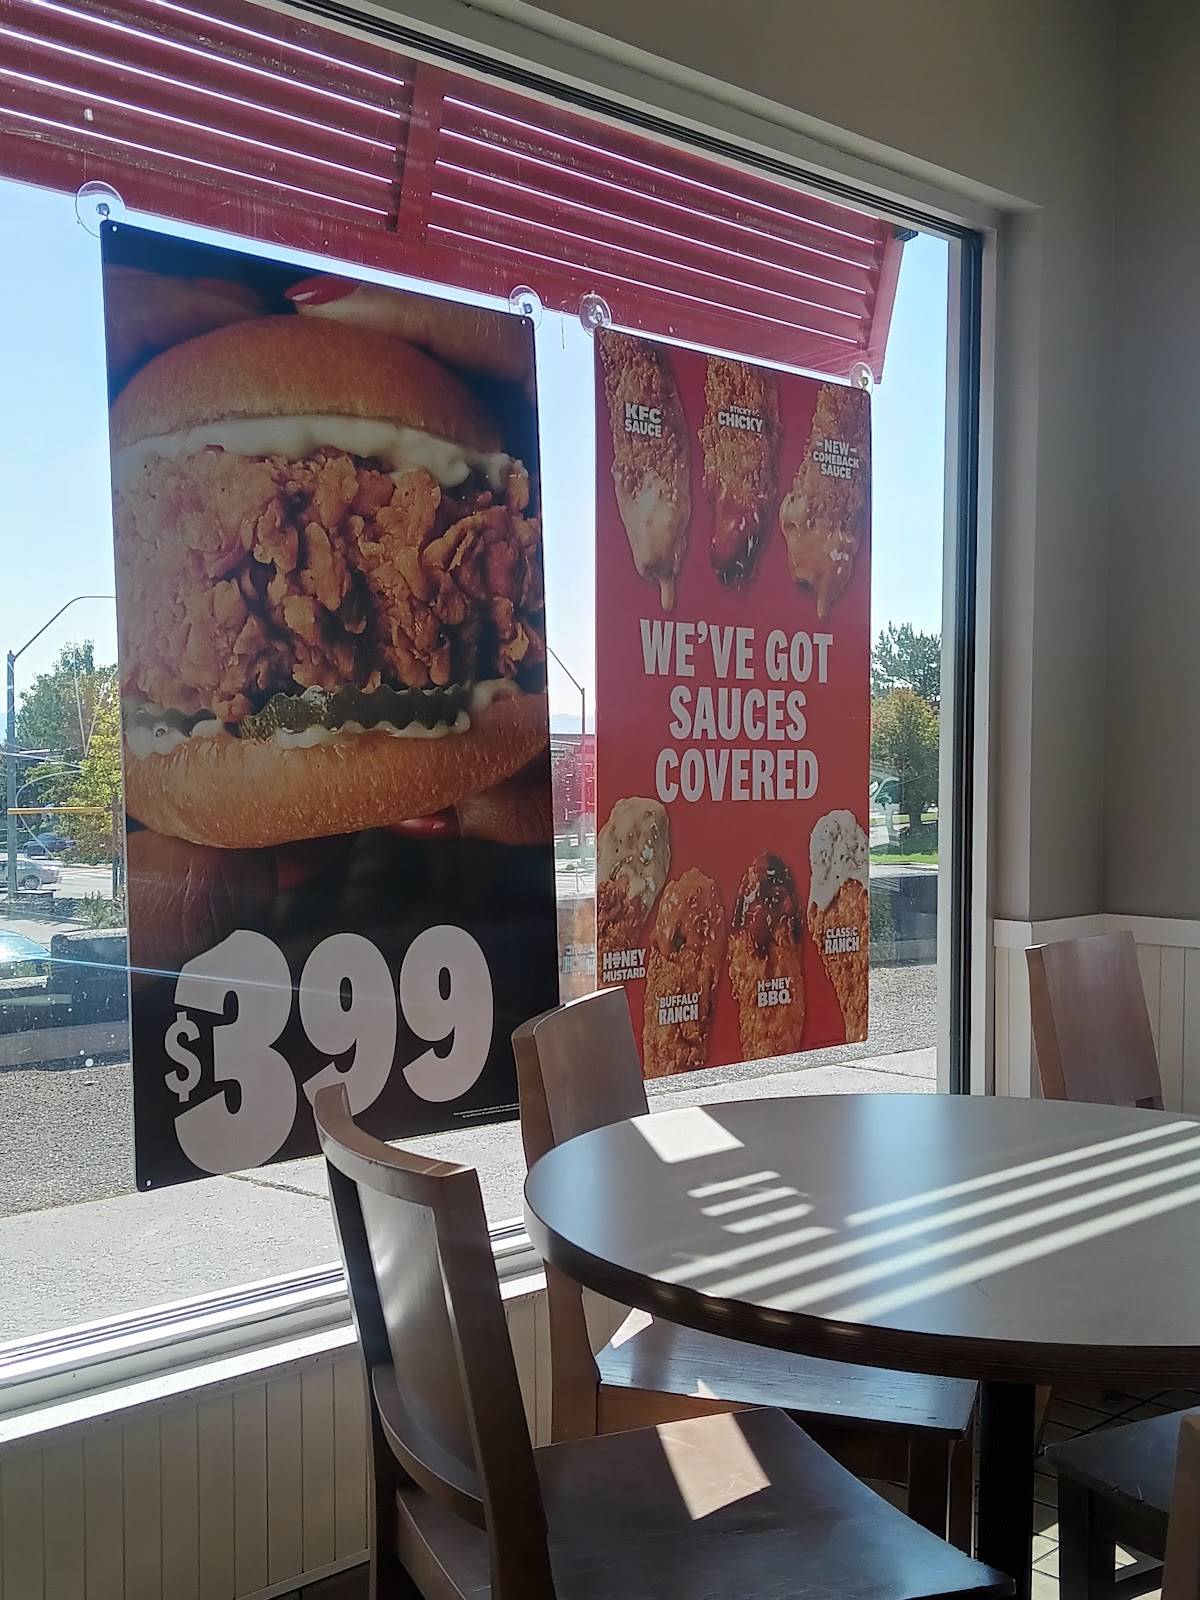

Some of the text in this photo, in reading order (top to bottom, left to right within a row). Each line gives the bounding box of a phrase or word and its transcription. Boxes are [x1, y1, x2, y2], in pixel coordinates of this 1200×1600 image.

[625, 403, 661, 424] KFC
[729, 405, 752, 416] STICKY
[624, 418, 662, 438] SAUCE
[718, 411, 763, 433] CHICKY
[824, 439, 850, 455] NEW
[812, 450, 859, 469] COMEBACK
[820, 463, 852, 479] SAUCE
[765, 629, 833, 683] GOT
[669, 685, 807, 742] SAUCES
[655, 748, 819, 803] COVERED
[826, 927, 858, 940] CLASSIC
[824, 936, 860, 955] RANCH
[602, 949, 646, 969] HONEY
[602, 966, 646, 984] MUSTARD
[757, 977, 791, 992] HONEY
[659, 993, 699, 1005] BUFFALO
[757, 991, 792, 1007] BBQ
[658, 1003, 699, 1026] RANCH
